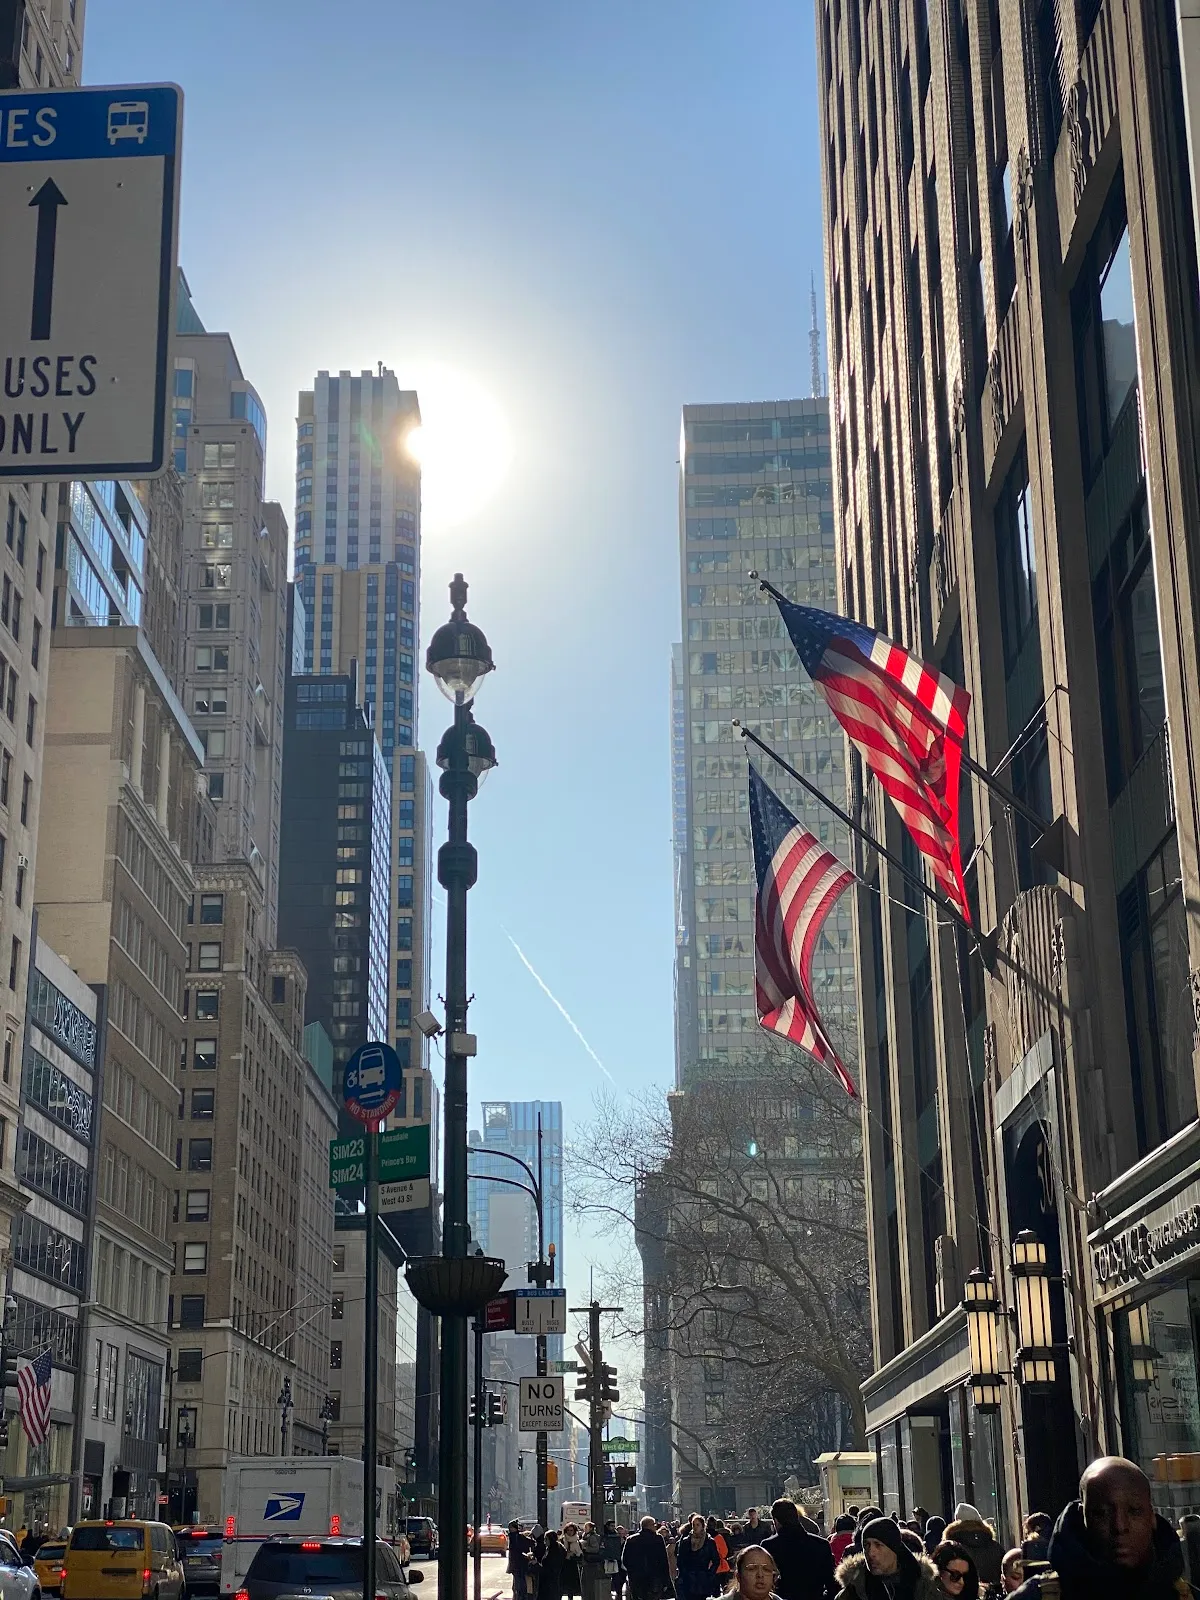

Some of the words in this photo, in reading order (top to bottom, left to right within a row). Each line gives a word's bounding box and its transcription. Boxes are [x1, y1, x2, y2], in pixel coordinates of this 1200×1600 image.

[0, 107, 58, 149] ES
[0, 411, 86, 455] NLY
[349, 1102, 361, 1115] NO
[360, 1096, 396, 1119] STANDING
[332, 1138, 365, 1160] SIM23
[381, 1157, 404, 1167] Prince's
[405, 1155, 417, 1165] Bay
[332, 1163, 364, 1184] SIM24
[381, 1185, 385, 1195] 5
[386, 1184, 408, 1195] Avenue
[409, 1182, 414, 1191] &
[381, 1197, 396, 1206] West
[528, 1384, 555, 1399] NO
[521, 1404, 562, 1417] TURNS
[521, 1420, 542, 1428] EXCEPT
[601, 1443, 617, 1451] West
